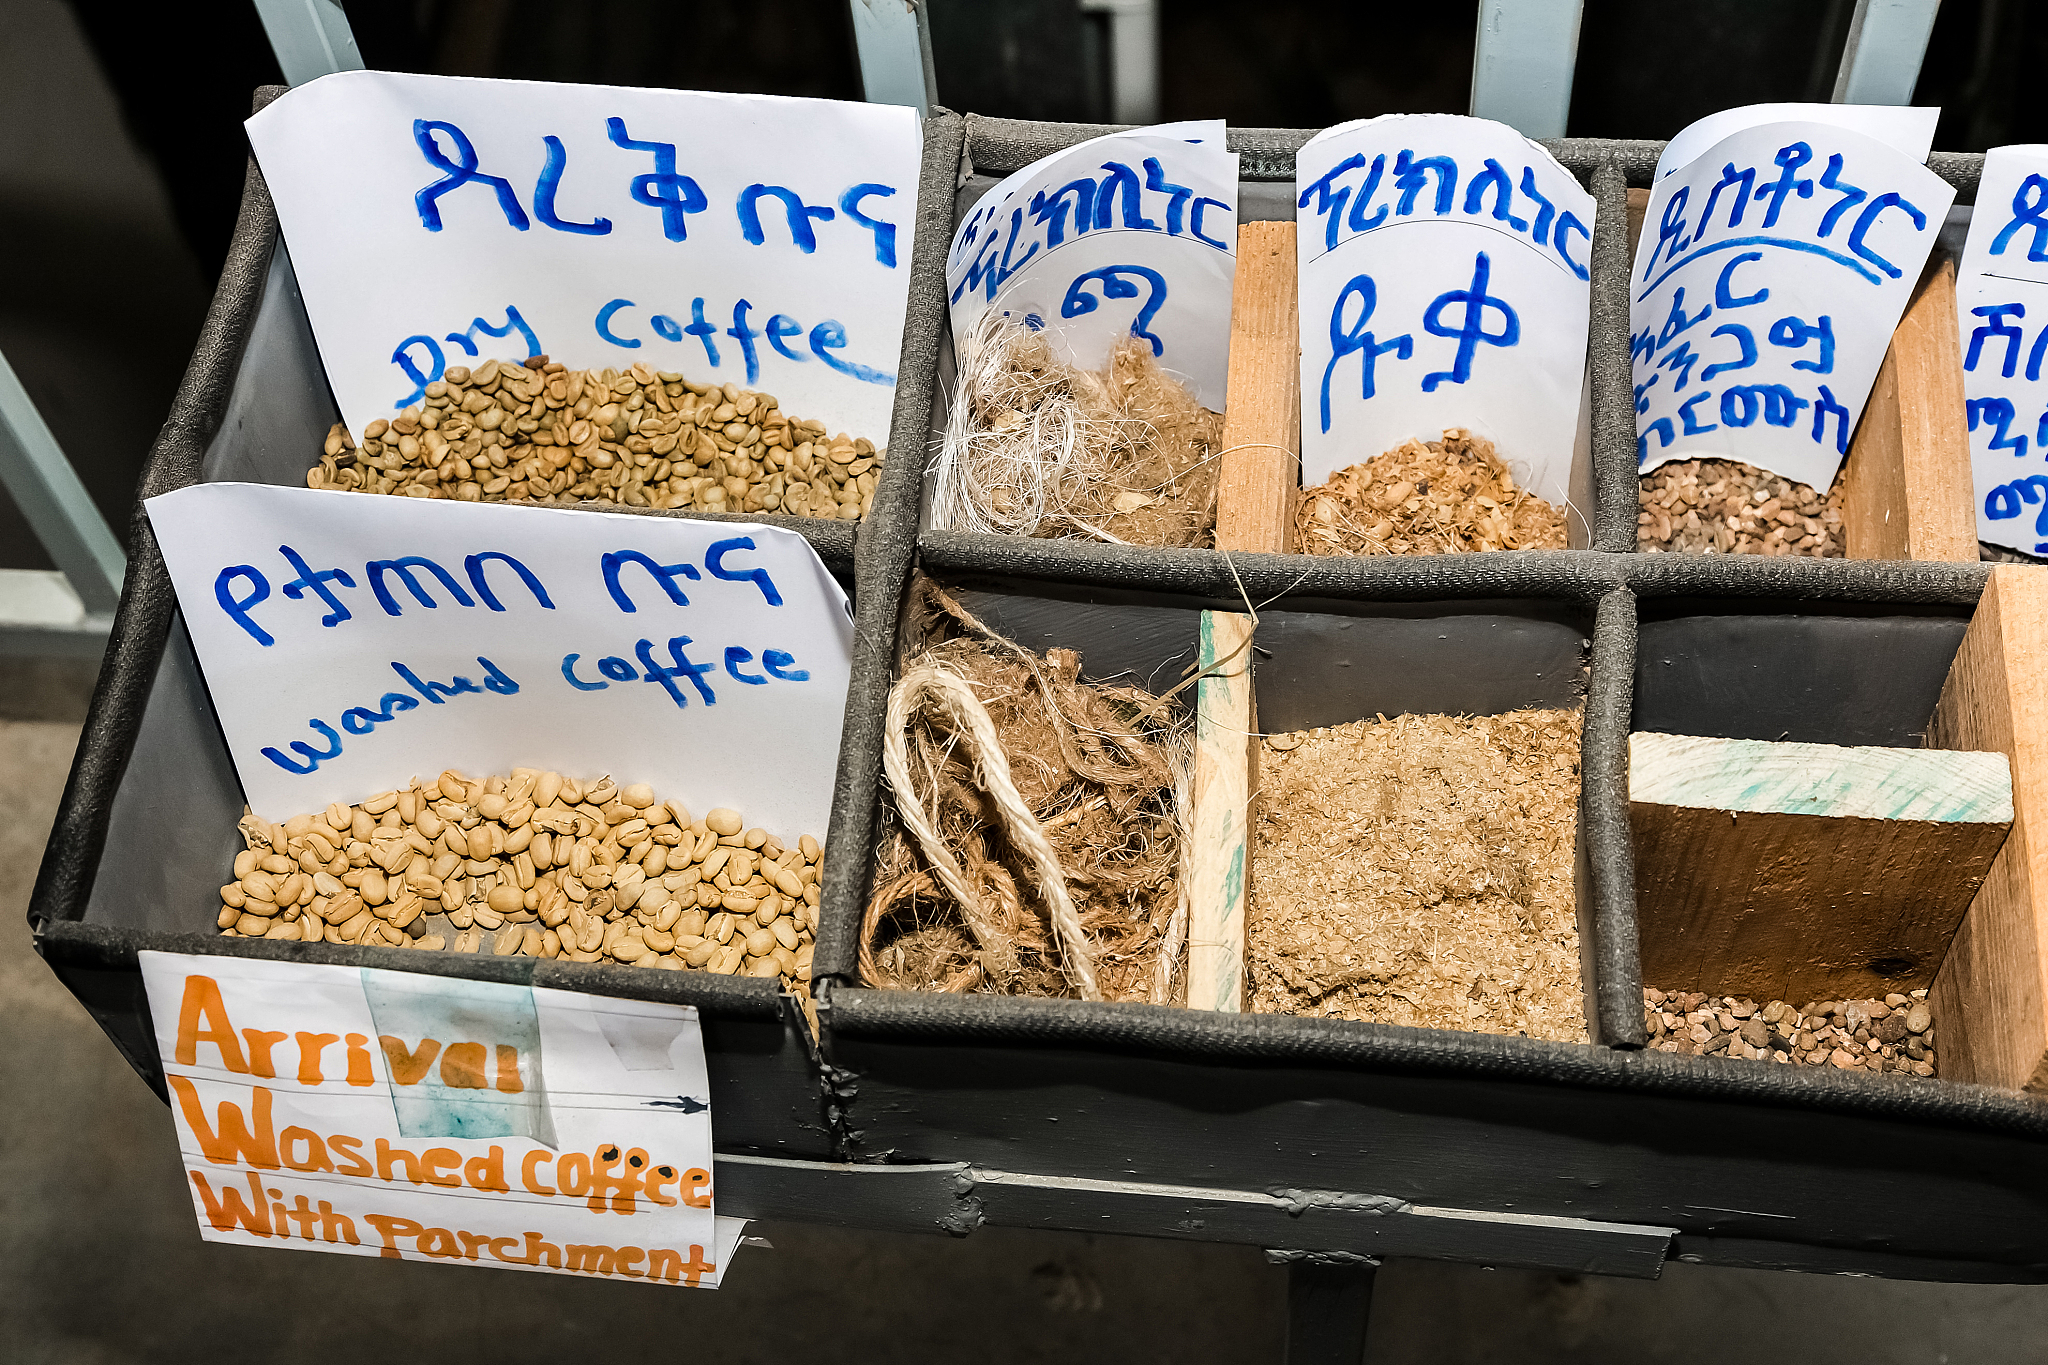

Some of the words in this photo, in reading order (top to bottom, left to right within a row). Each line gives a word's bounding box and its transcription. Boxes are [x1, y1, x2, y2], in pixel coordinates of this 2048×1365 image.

[735, 182, 898, 269] ቡና
[390, 304, 543, 410] Dry
[600, 536, 784, 614] ቡና
[167, 1073, 510, 1195] Washed
[189, 1170, 362, 1247] With
[364, 1213, 717, 1289] Parchment
